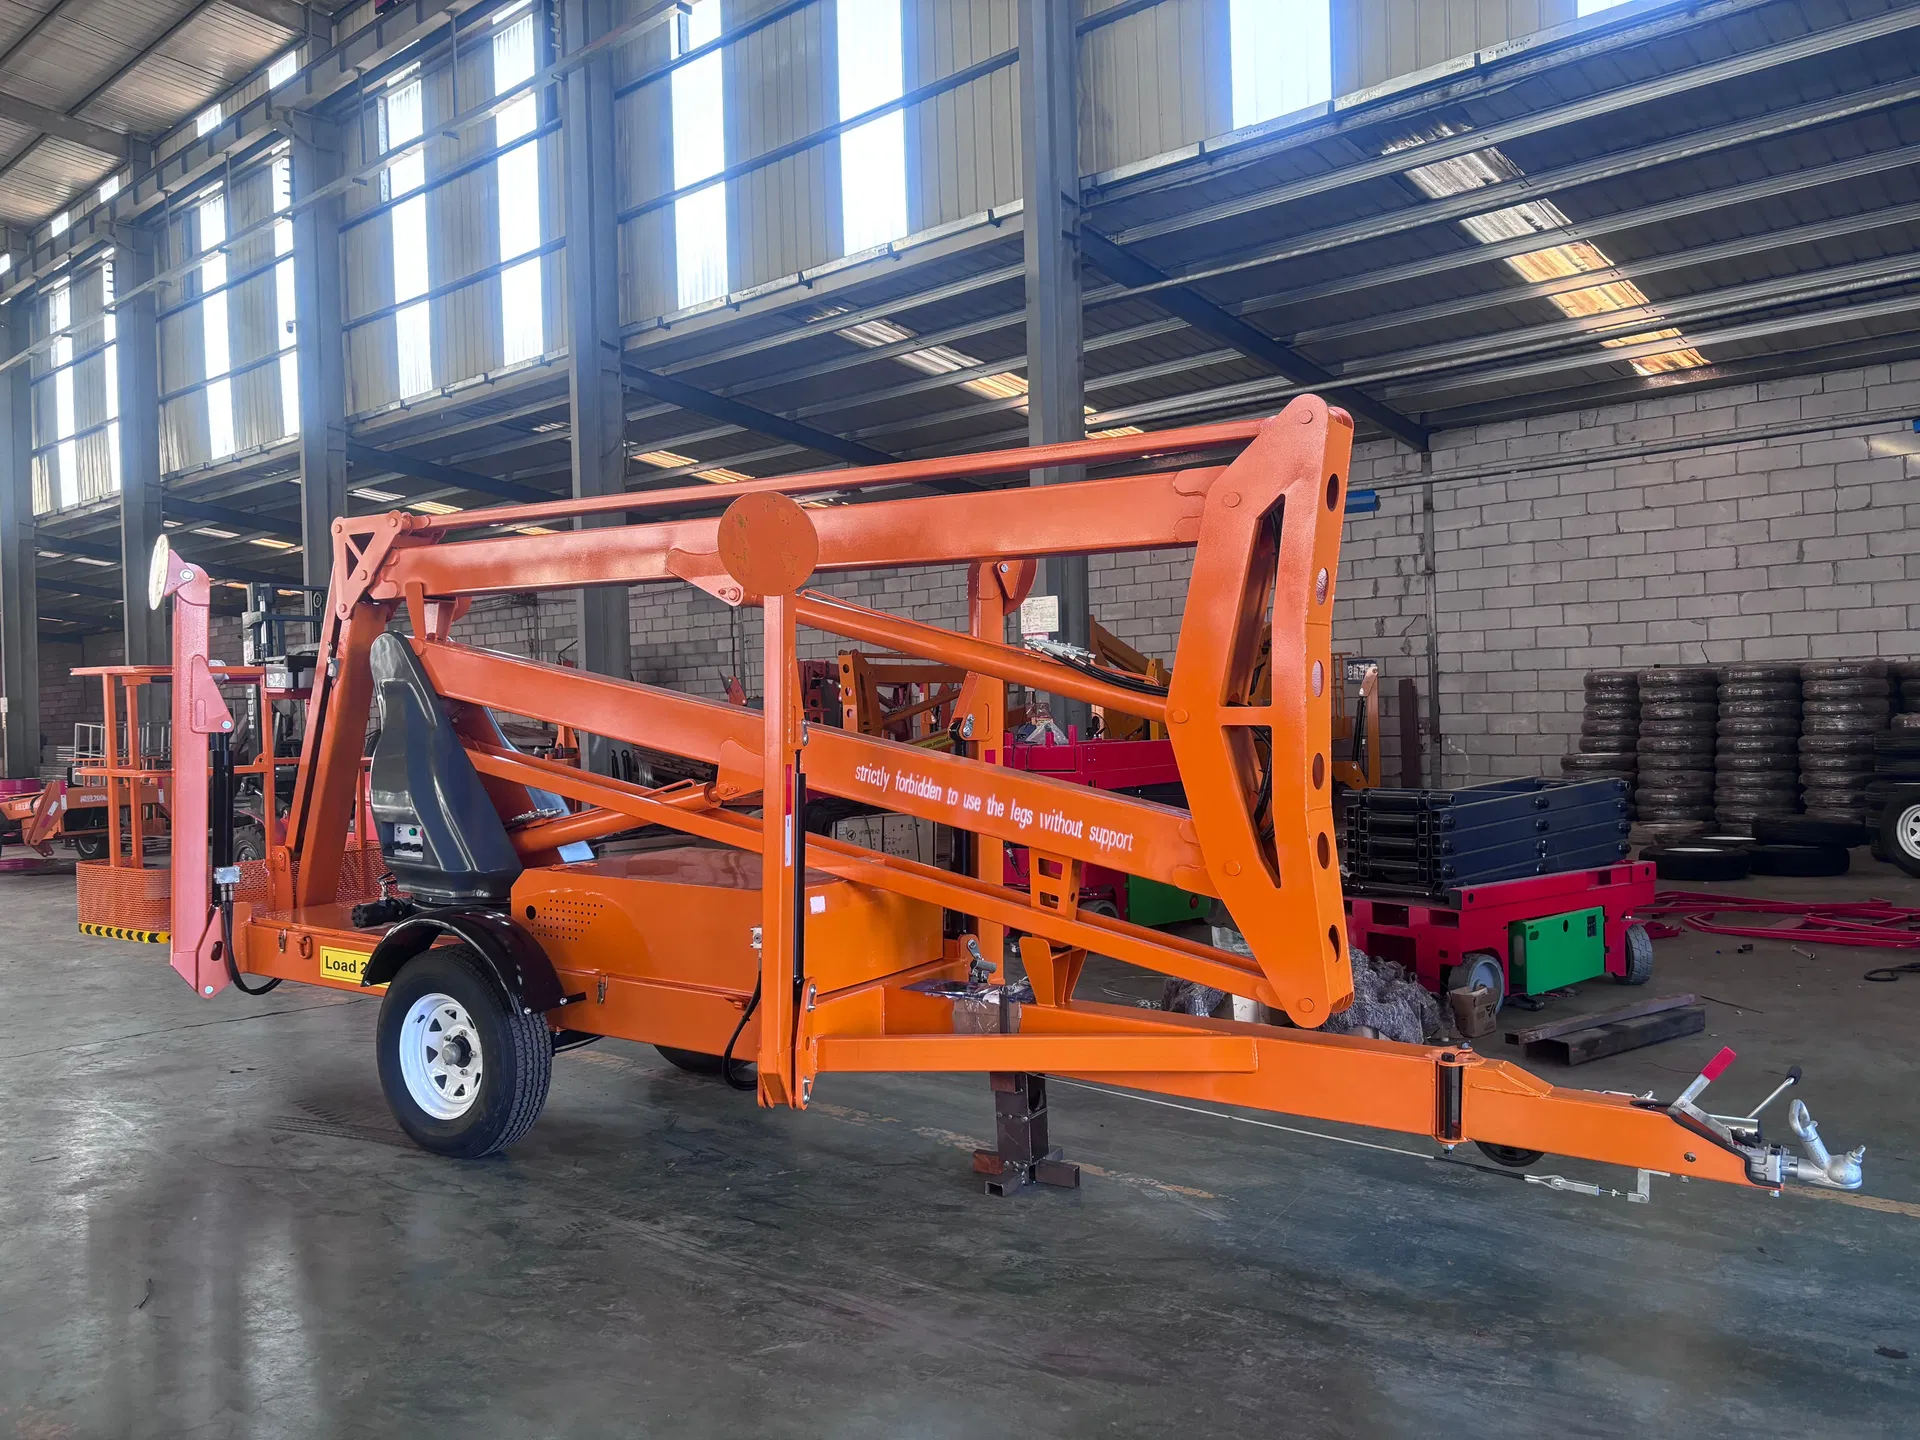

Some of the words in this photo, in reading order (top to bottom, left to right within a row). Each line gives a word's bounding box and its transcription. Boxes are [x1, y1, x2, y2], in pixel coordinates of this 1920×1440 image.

[247, 688, 255, 729] HELI
[855, 763, 890, 792] strictly
[895, 770, 942, 801] forbidden
[946, 787, 959, 806] to
[963, 793, 982, 812] use
[986, 794, 1005, 817] the
[1010, 798, 1034, 830] legs
[1040, 809, 1083, 839] without
[1089, 825, 1134, 852] support
[325, 955, 357, 974] Load
